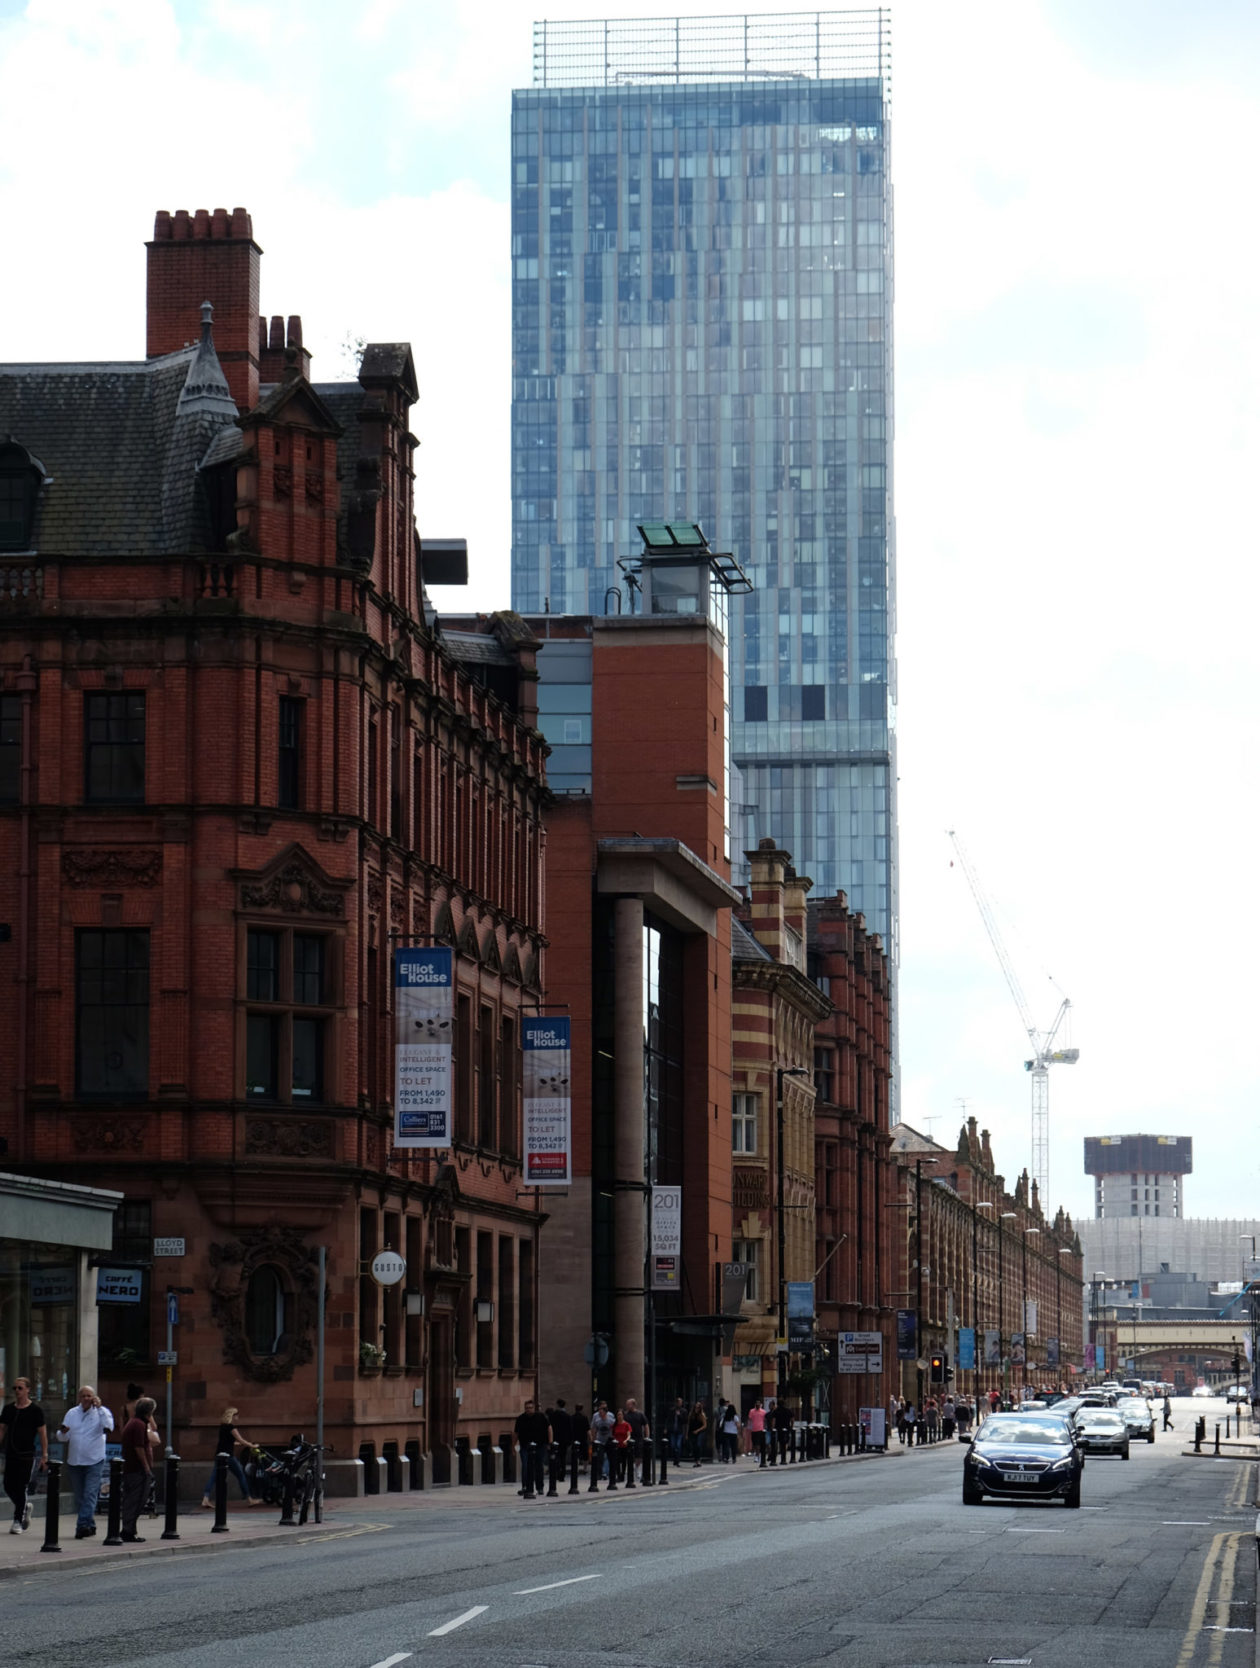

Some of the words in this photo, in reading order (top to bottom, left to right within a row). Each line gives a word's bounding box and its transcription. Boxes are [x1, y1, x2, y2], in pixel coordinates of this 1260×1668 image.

[400, 963, 434, 974] Elliot
[408, 973, 448, 983] House
[526, 1030, 556, 1040] Elliot
[533, 1038, 567, 1047] House
[400, 1077, 413, 1085] TO
[415, 1077, 432, 1085] LET
[425, 1090, 446, 1098] 1,490
[655, 1194, 679, 1209] 201
[156, 1239, 183, 1247] LLOYD
[375, 1263, 403, 1272] GUSTO
[725, 1264, 745, 1275] 201
[98, 1285, 139, 1296] NERO
